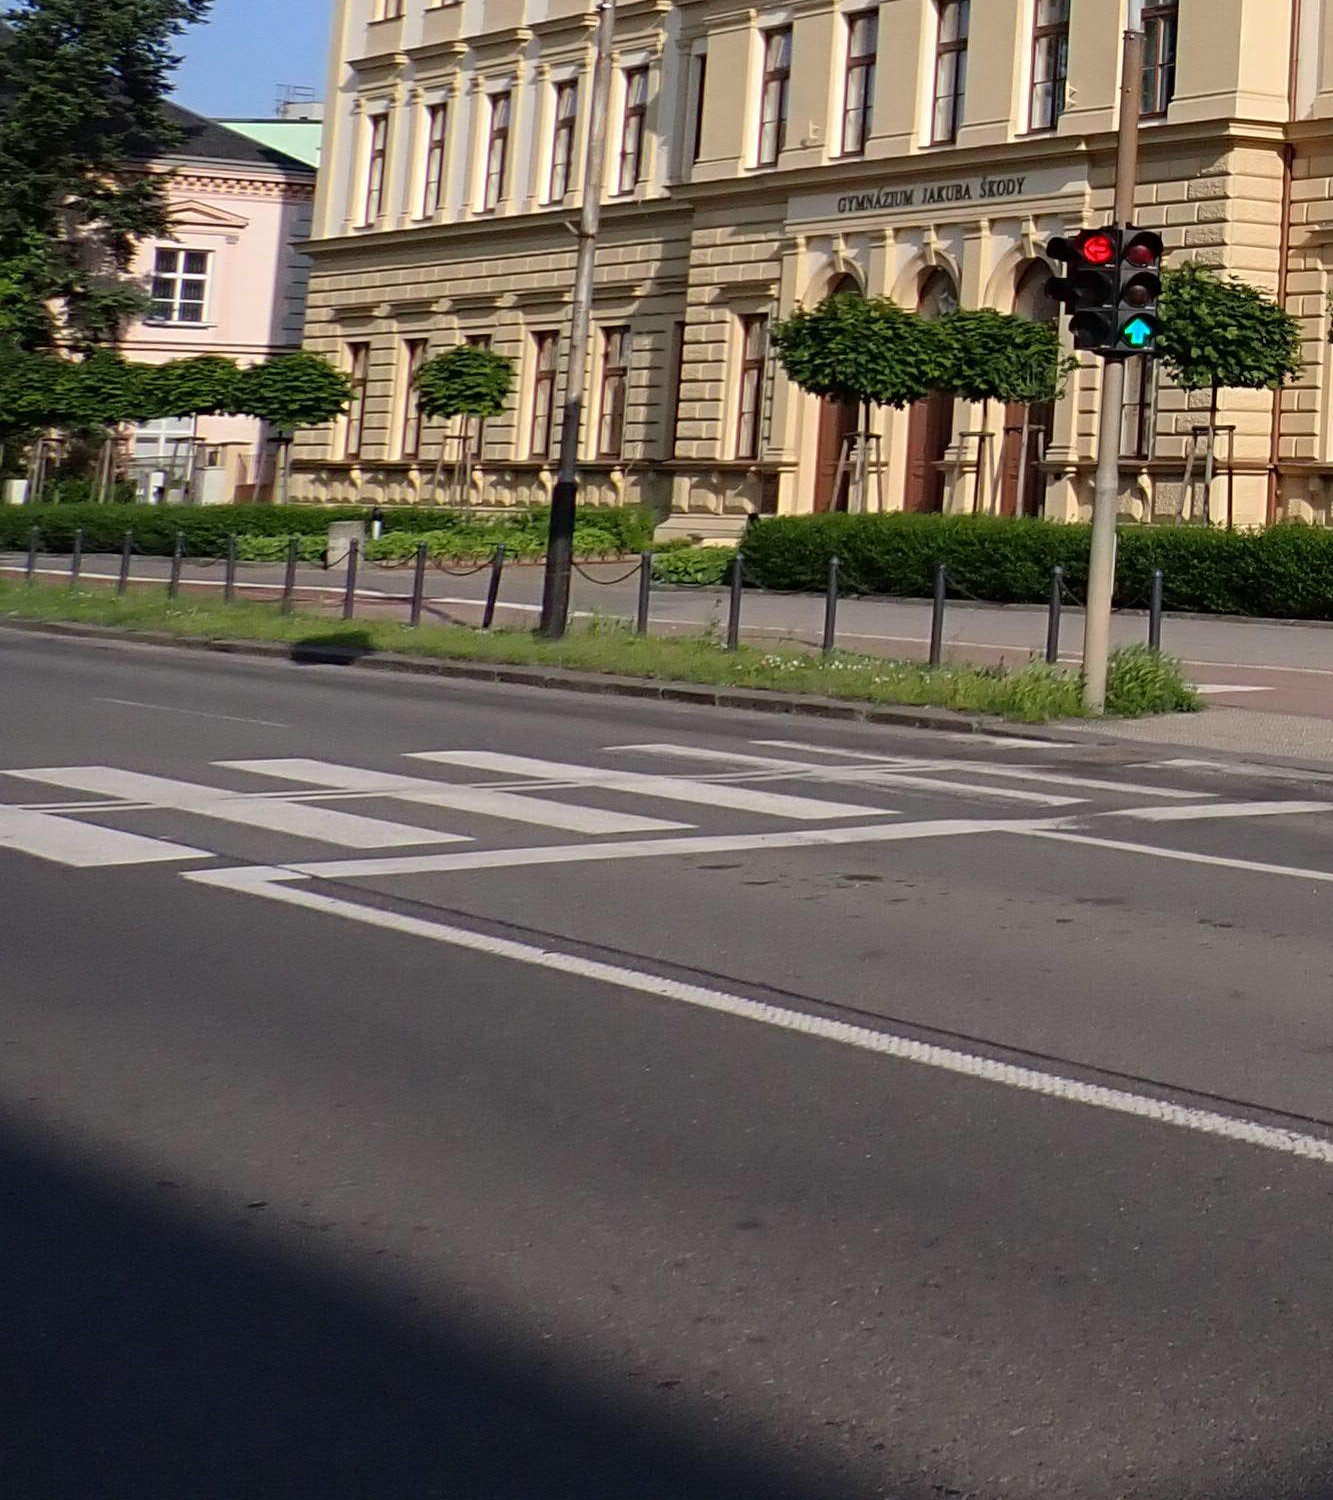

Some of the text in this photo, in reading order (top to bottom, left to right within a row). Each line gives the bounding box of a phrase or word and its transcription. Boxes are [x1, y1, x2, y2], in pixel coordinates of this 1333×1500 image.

[838, 176, 1027, 213] GYMNÁZIUM JAKUBA ŠKODY
